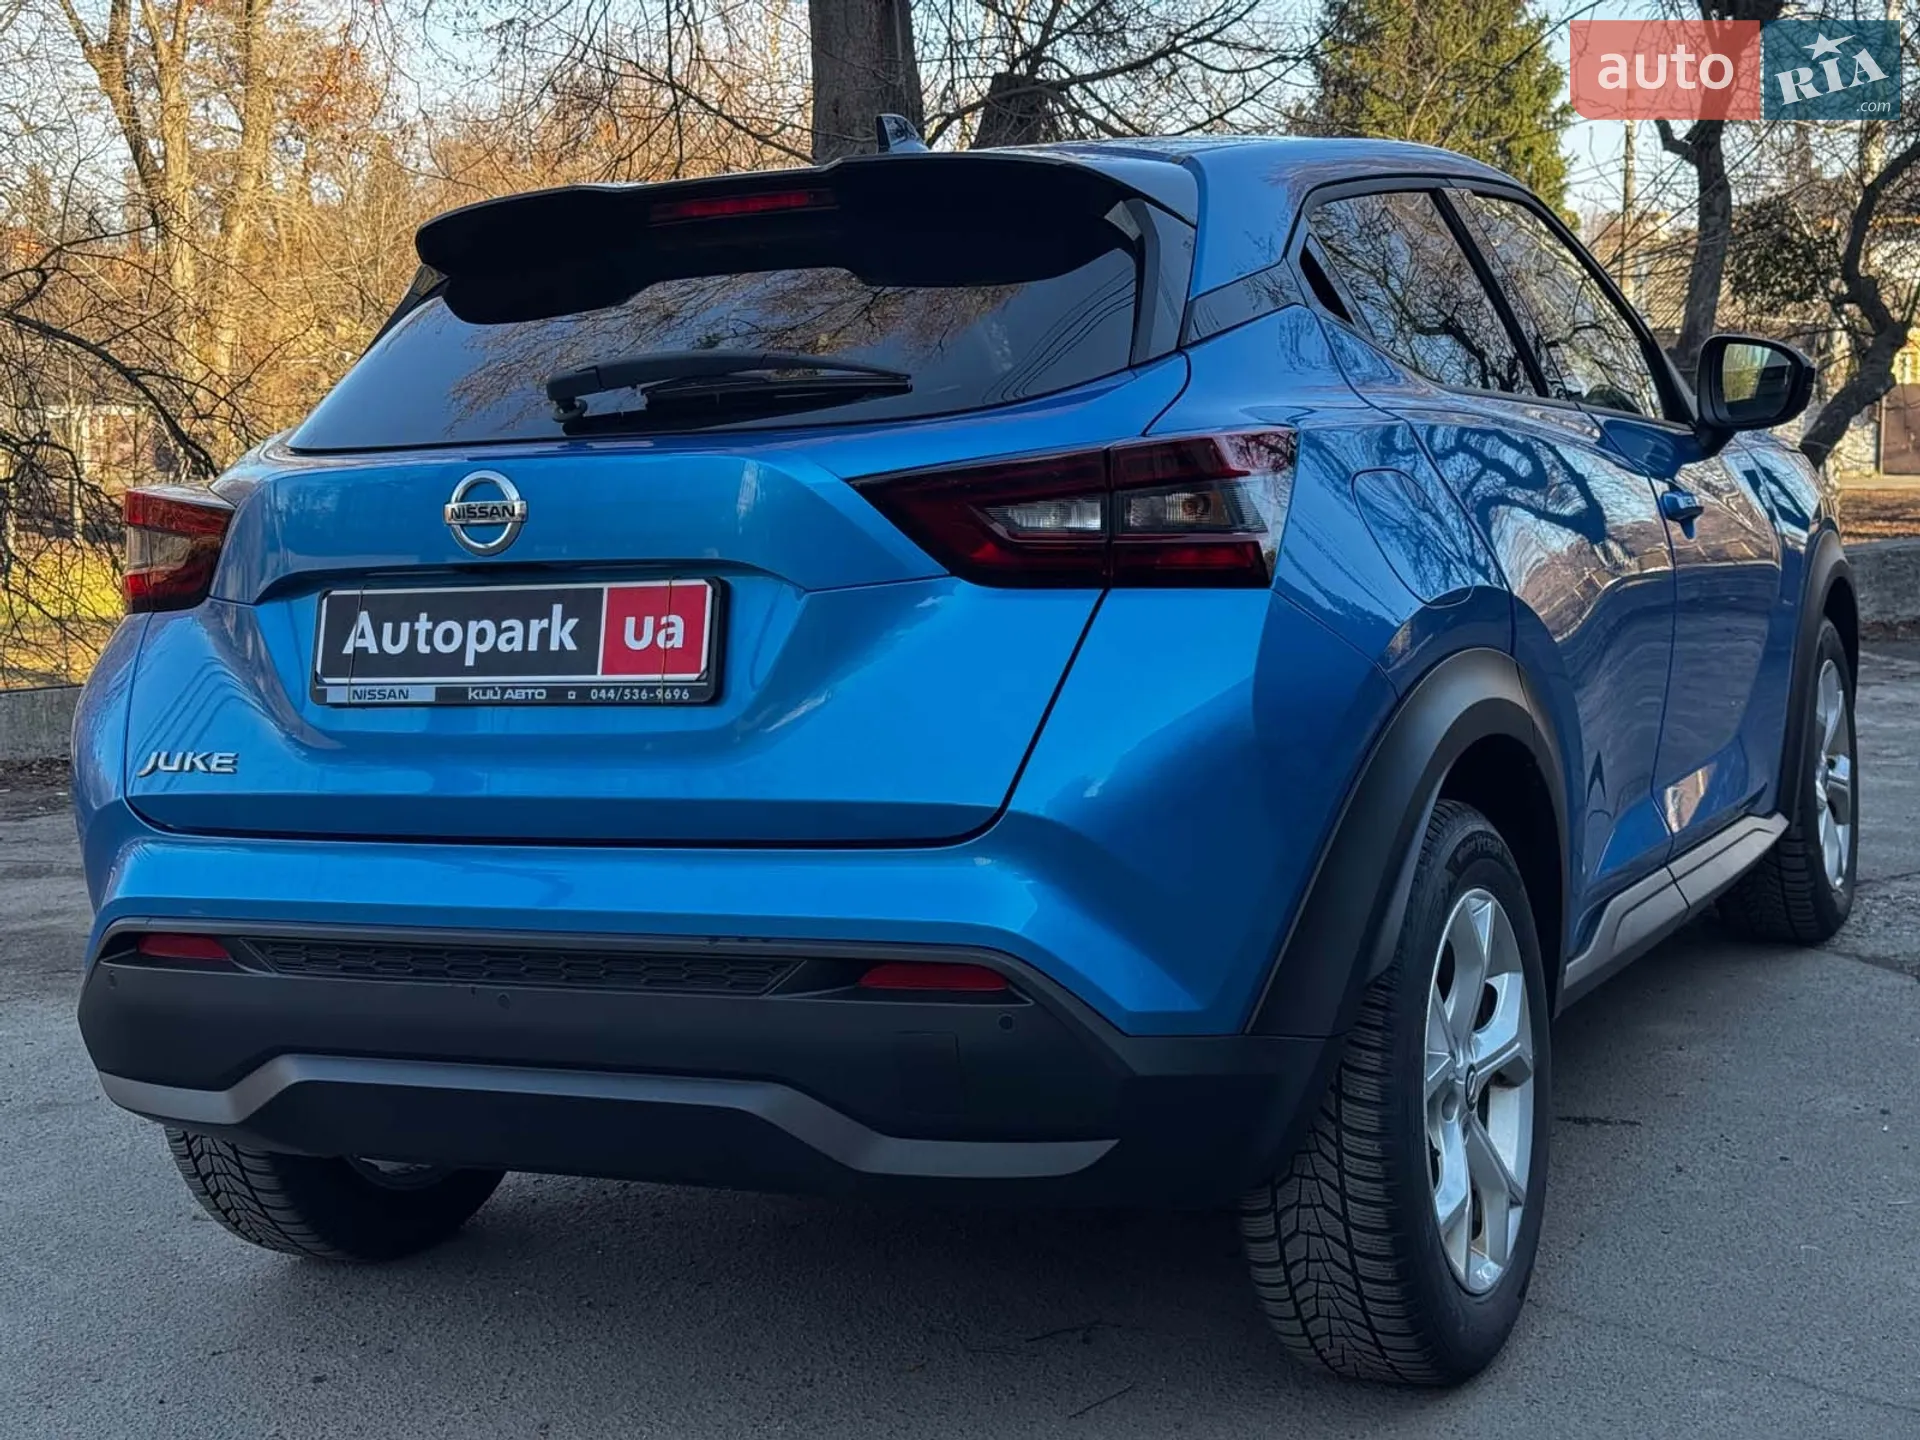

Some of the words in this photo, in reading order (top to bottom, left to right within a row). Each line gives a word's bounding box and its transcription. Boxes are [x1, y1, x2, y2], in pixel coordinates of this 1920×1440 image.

[450, 505, 516, 520] NISSAN
[342, 603, 579, 667] Autopark
[624, 613, 684, 650] ua
[352, 688, 410, 701] NISSAN
[590, 687, 690, 701] 044/536-9696
[136, 751, 239, 778] JUKE
